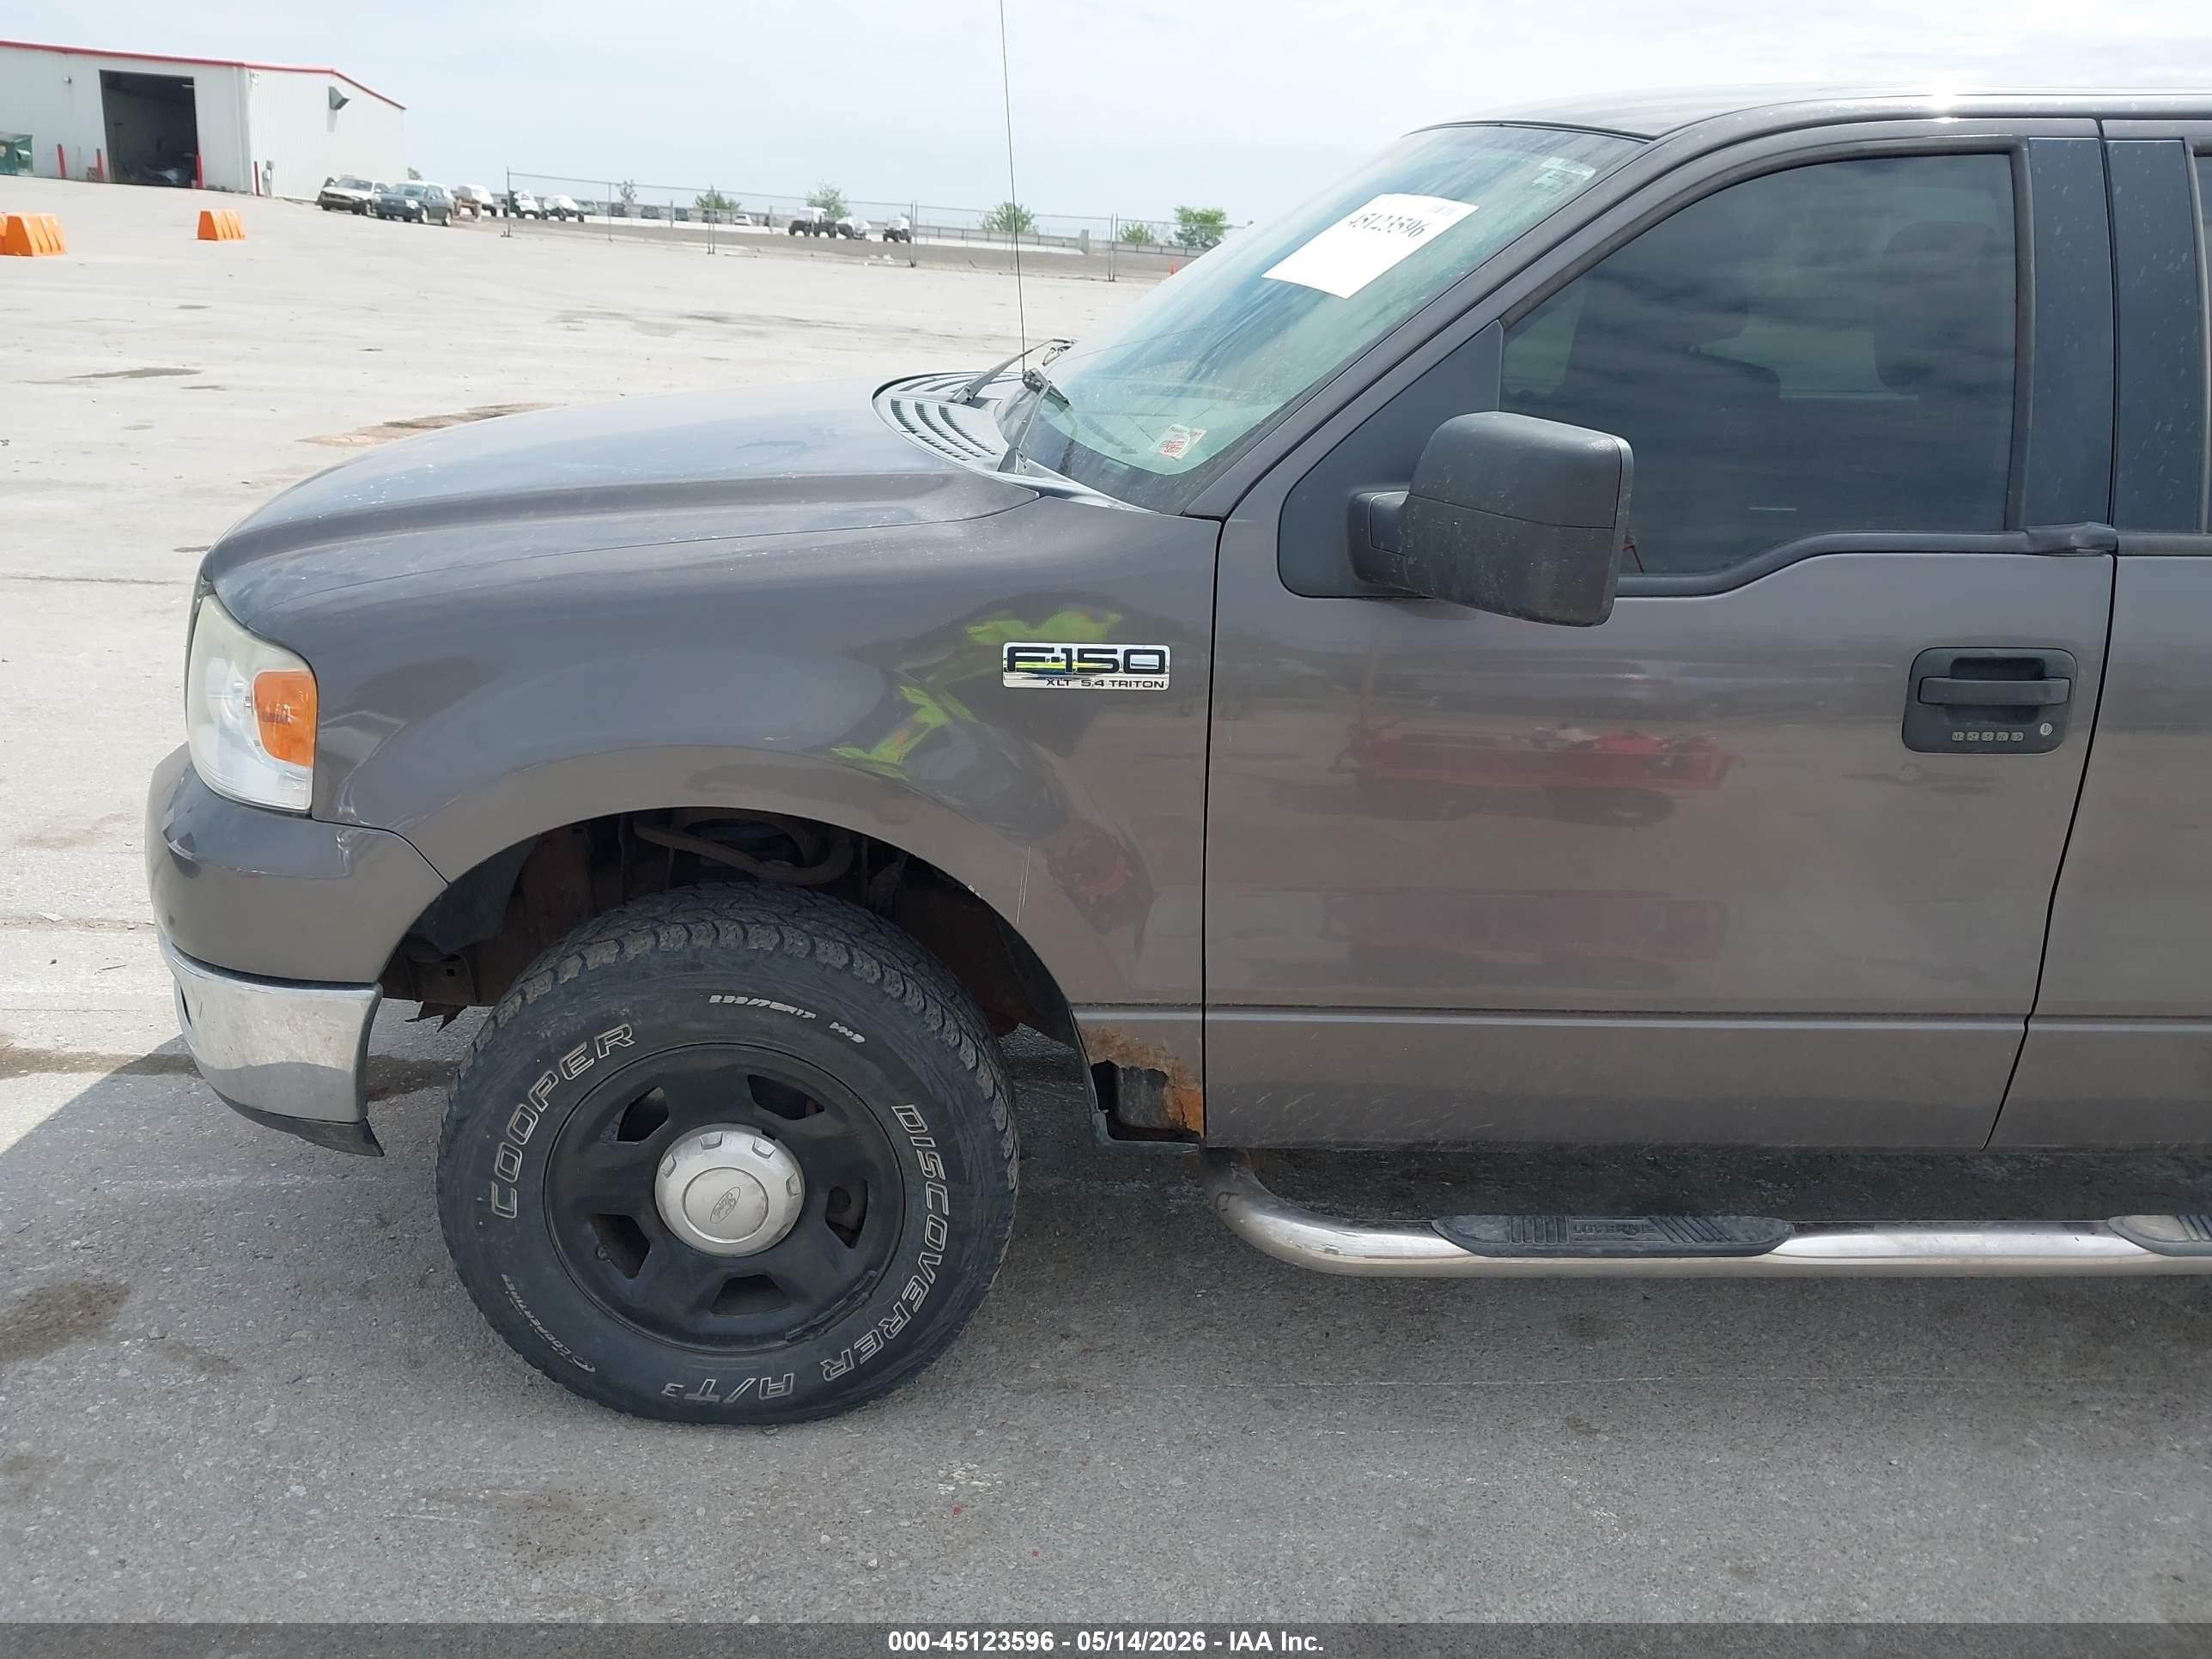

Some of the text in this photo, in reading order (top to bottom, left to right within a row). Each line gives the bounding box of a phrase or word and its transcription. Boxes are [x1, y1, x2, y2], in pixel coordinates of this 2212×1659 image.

[1006, 646, 1166, 674] F-150
[1045, 678, 1072, 687] XLT
[1109, 679, 1165, 689] TRITON
[490, 1023, 635, 1218] COOPER
[819, 1103, 950, 1382] DISCOVERER
